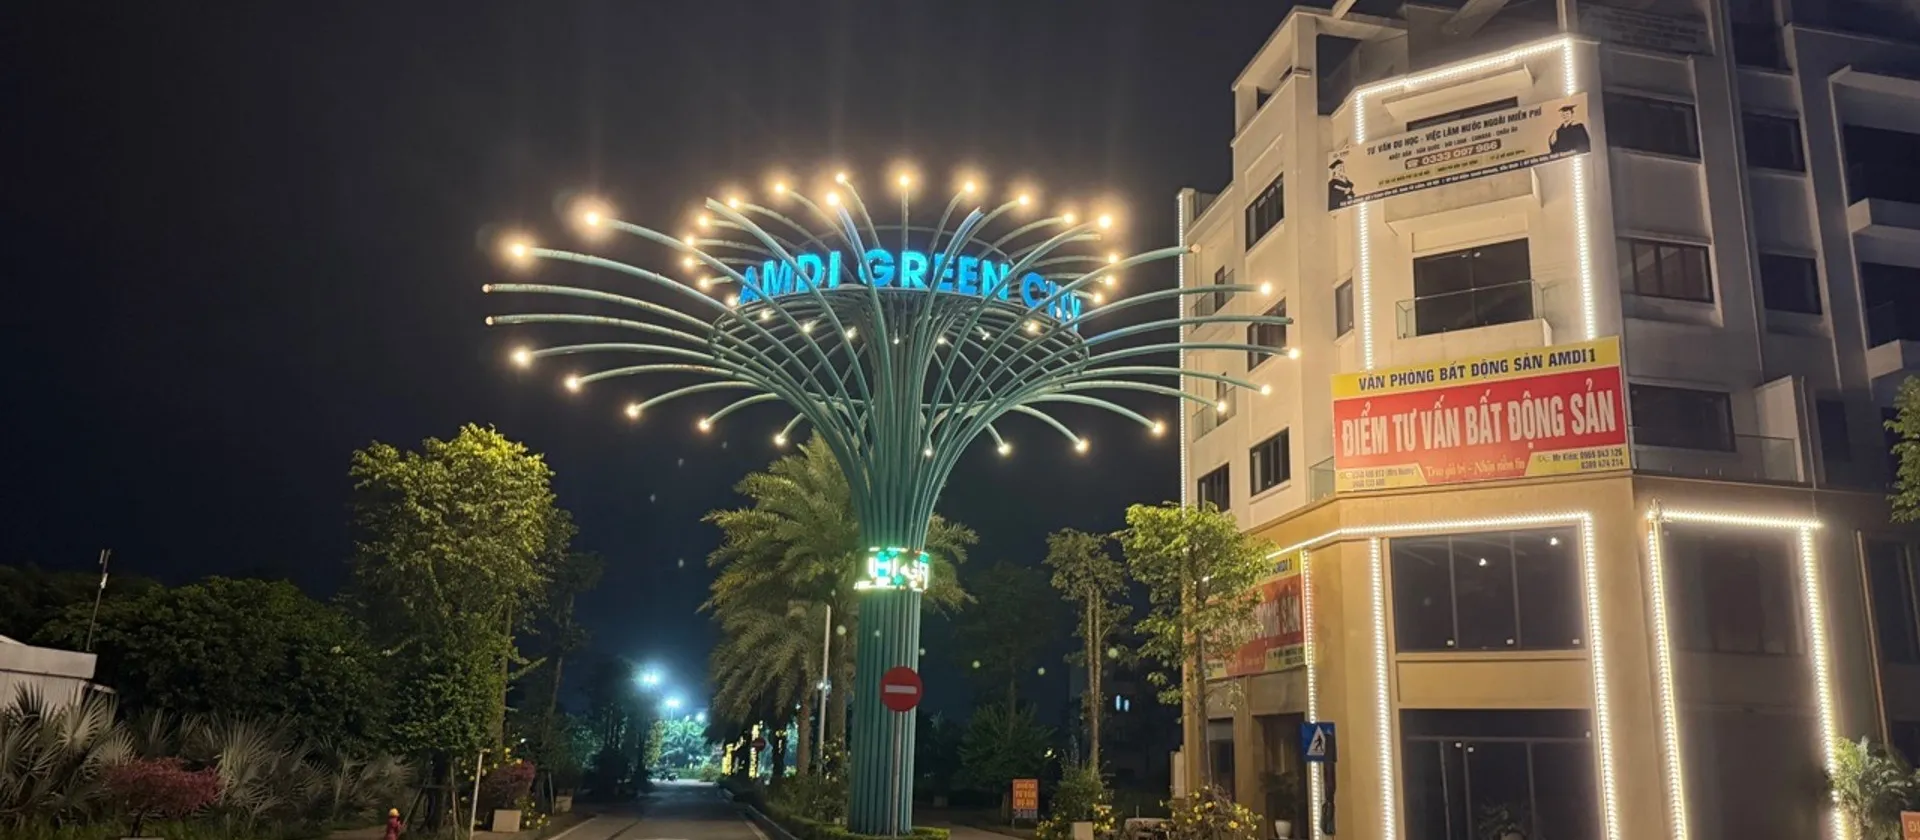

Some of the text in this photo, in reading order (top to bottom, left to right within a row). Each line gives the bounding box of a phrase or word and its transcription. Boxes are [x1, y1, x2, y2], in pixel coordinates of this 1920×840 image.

[1422, 152, 1451, 165] 0333
[738, 250, 842, 305] AMDI
[858, 248, 1010, 301] GREEN
[1390, 369, 1434, 387] PHÒNG
[1440, 361, 1467, 381] BẤT
[1471, 358, 1509, 379] ĐỘNG
[1514, 352, 1543, 371] SẢN
[1342, 378, 1616, 457] ĐIỂM TƯ VẤN BẤT ĐỘNG SẢN
